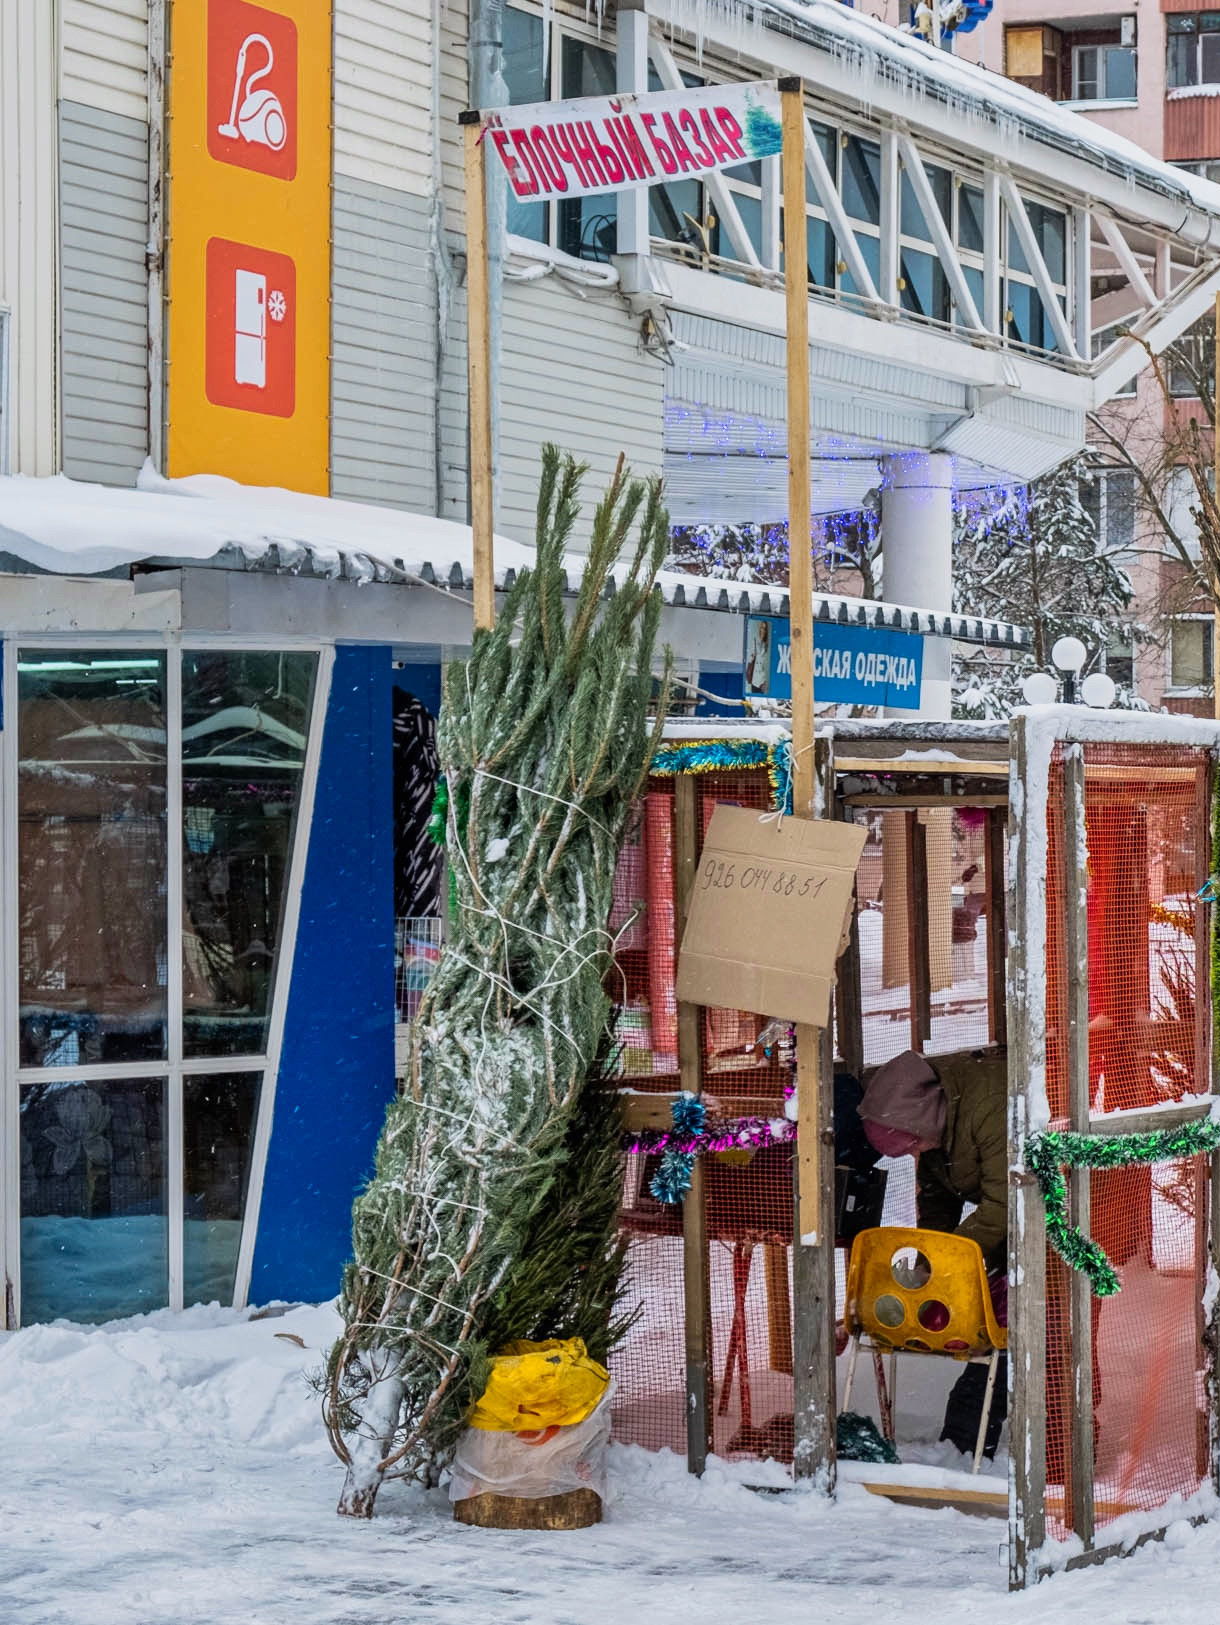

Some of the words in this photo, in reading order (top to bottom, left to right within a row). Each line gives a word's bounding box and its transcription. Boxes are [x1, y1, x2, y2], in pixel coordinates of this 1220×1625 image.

[639, 105, 747, 176] БАЗАР
[777, 643, 851, 679] ЖСКАЯ
[855, 652, 916, 691] ОДЕЖДА
[701, 859, 736, 890] 926
